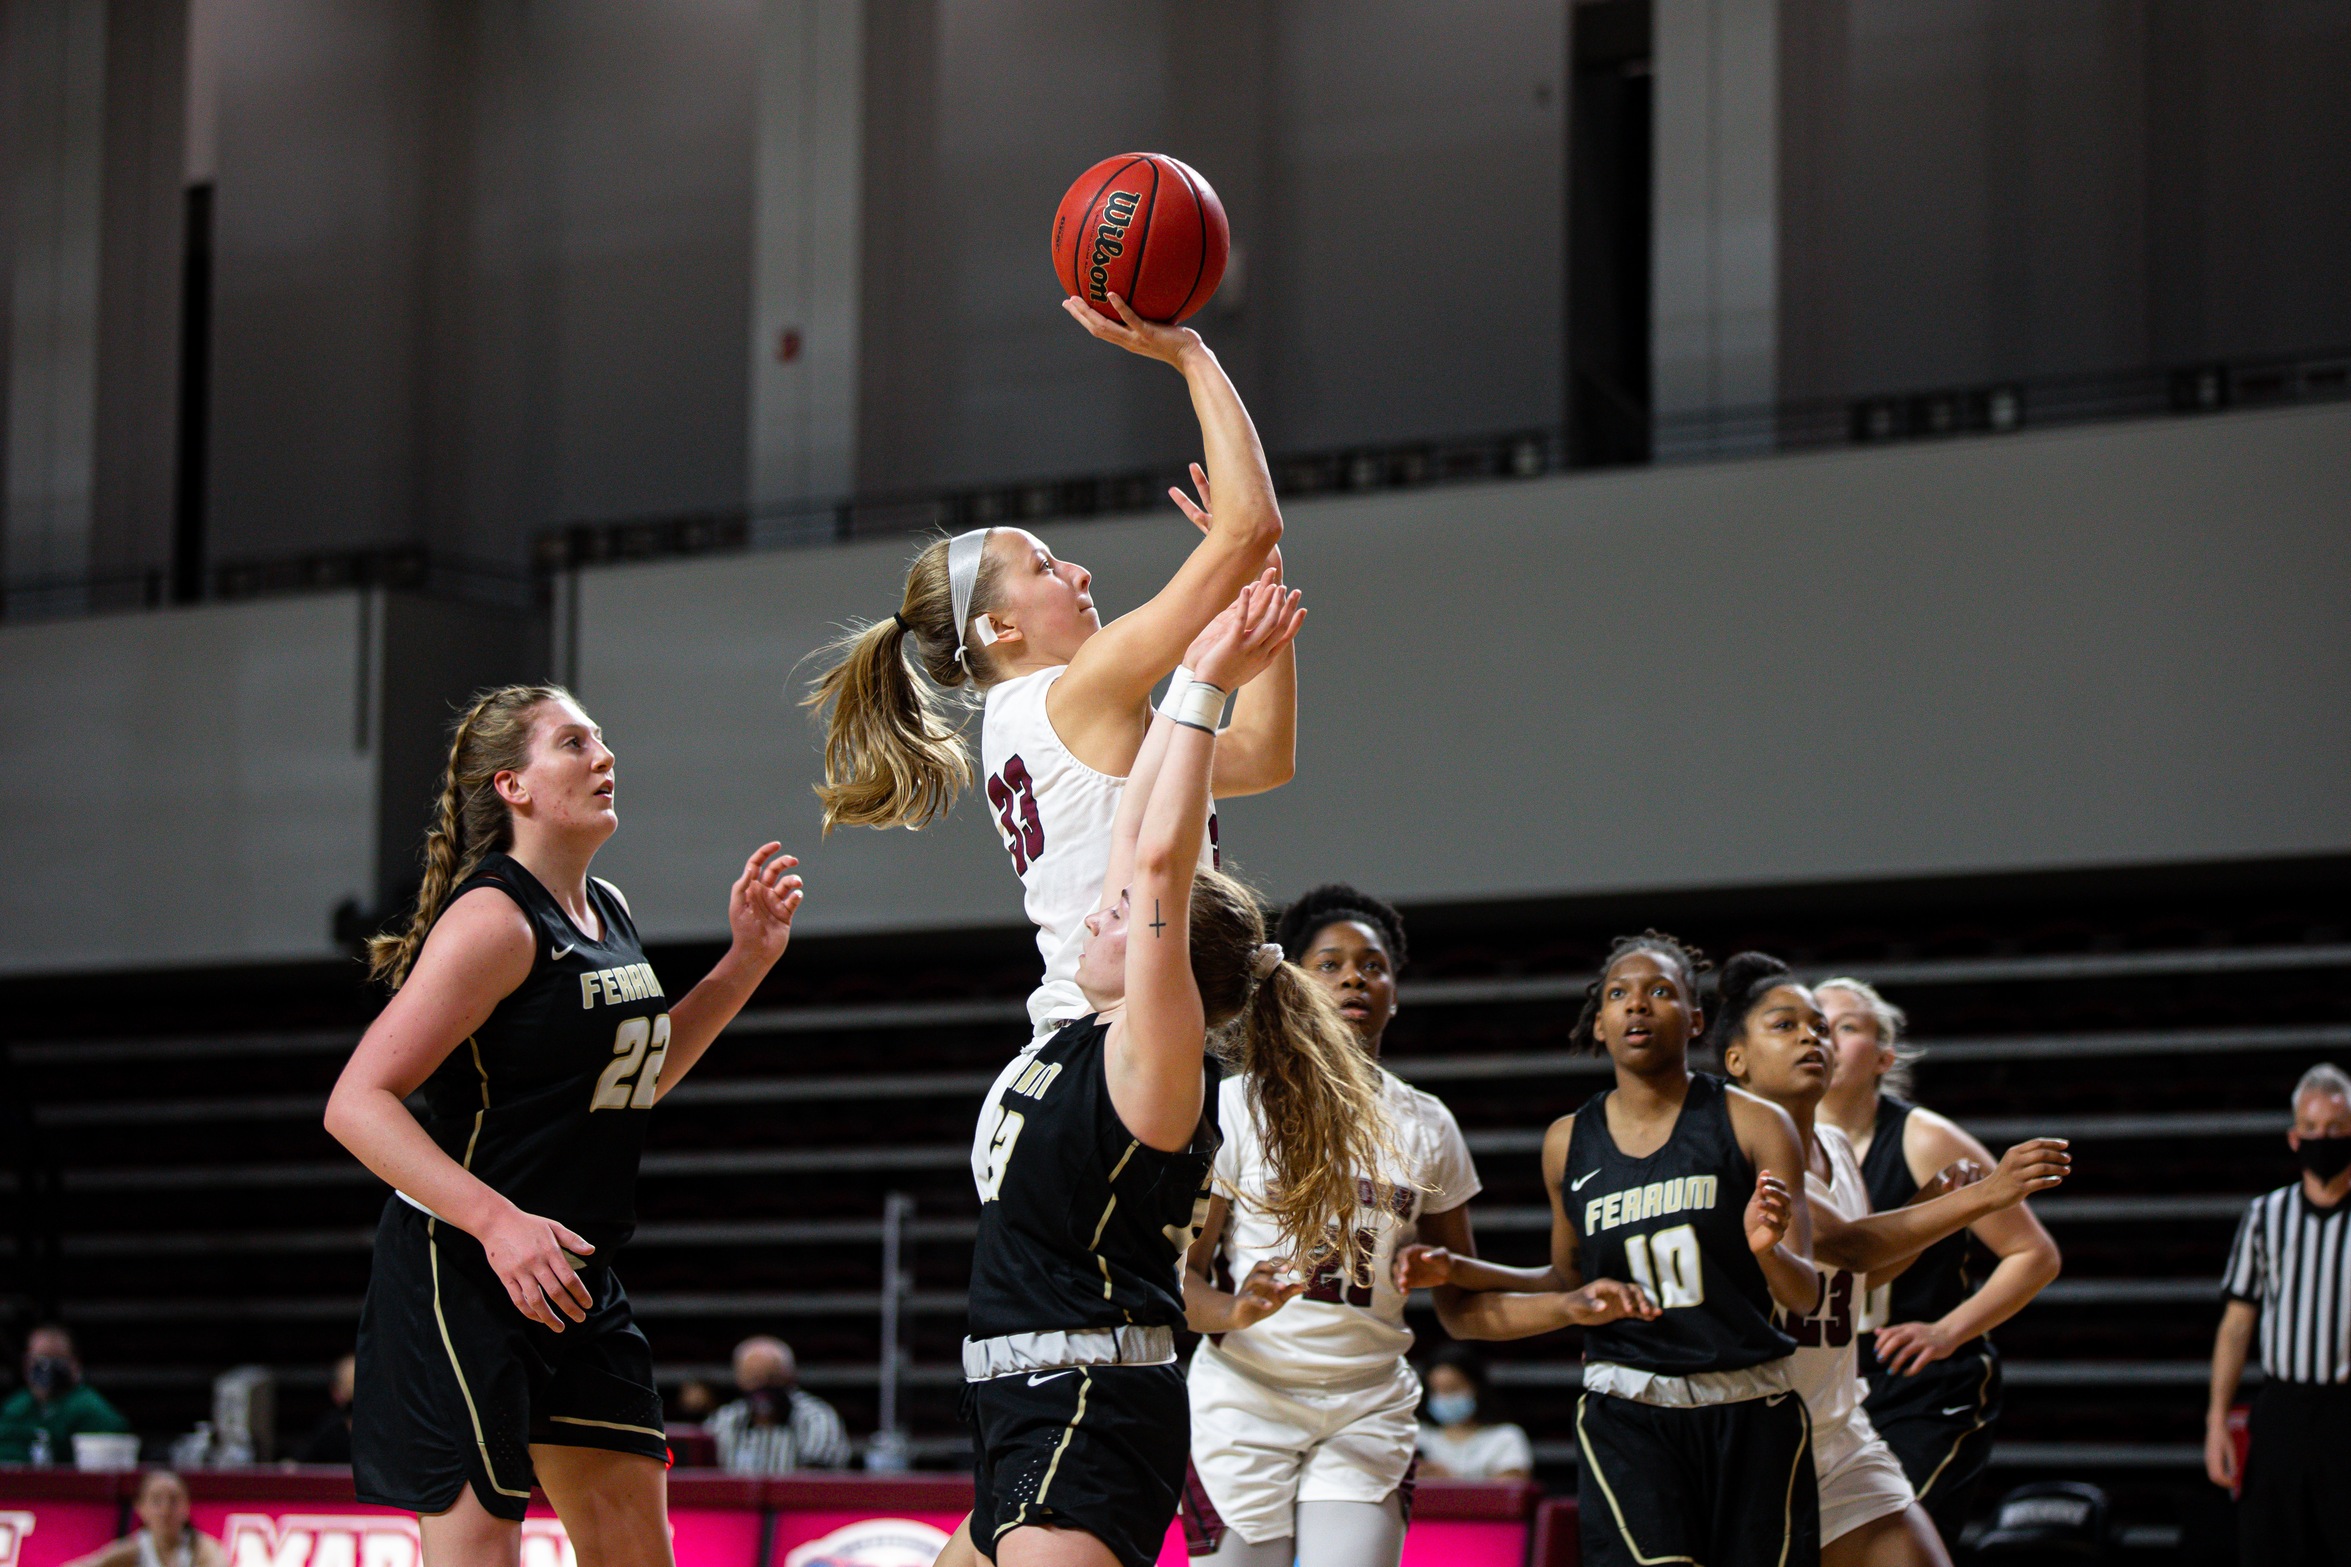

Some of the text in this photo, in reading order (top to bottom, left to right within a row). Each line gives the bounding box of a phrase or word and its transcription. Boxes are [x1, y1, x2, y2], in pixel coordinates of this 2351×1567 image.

[1088, 190, 1142, 303] Wilson
[987, 753, 1045, 878] 33
[579, 962, 665, 1010] FERRU
[589, 1013, 671, 1113] 22
[1585, 1174, 1718, 1237] FERRUM
[1624, 1223, 1704, 1309] 10
